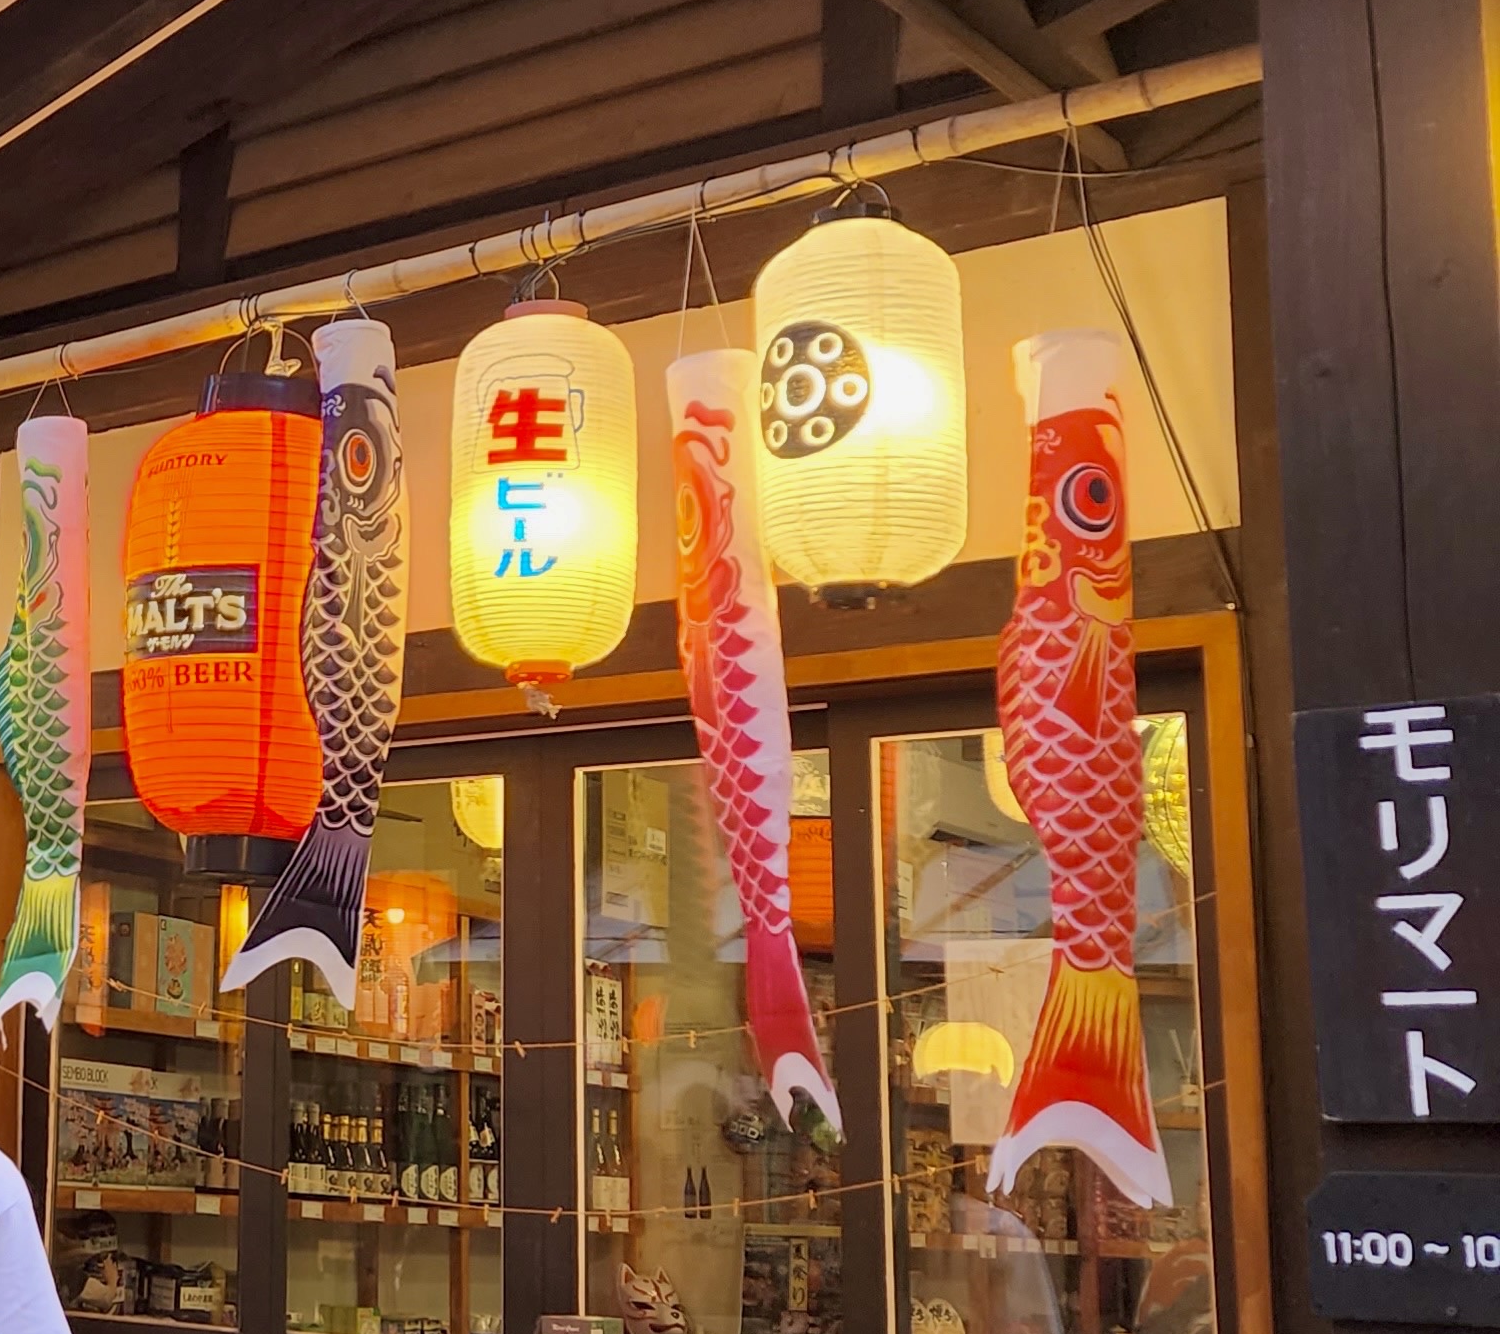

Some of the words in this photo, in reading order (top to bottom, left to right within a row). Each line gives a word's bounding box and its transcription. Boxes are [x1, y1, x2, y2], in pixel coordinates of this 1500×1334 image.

[486, 388, 568, 578] 生ビール
[151, 573, 193, 598] The
[128, 588, 247, 639] MALT'S
[174, 660, 255, 687] BEER
[1358, 705, 1478, 1117] モリマート
[1321, 1230, 1413, 1268] 11:00
